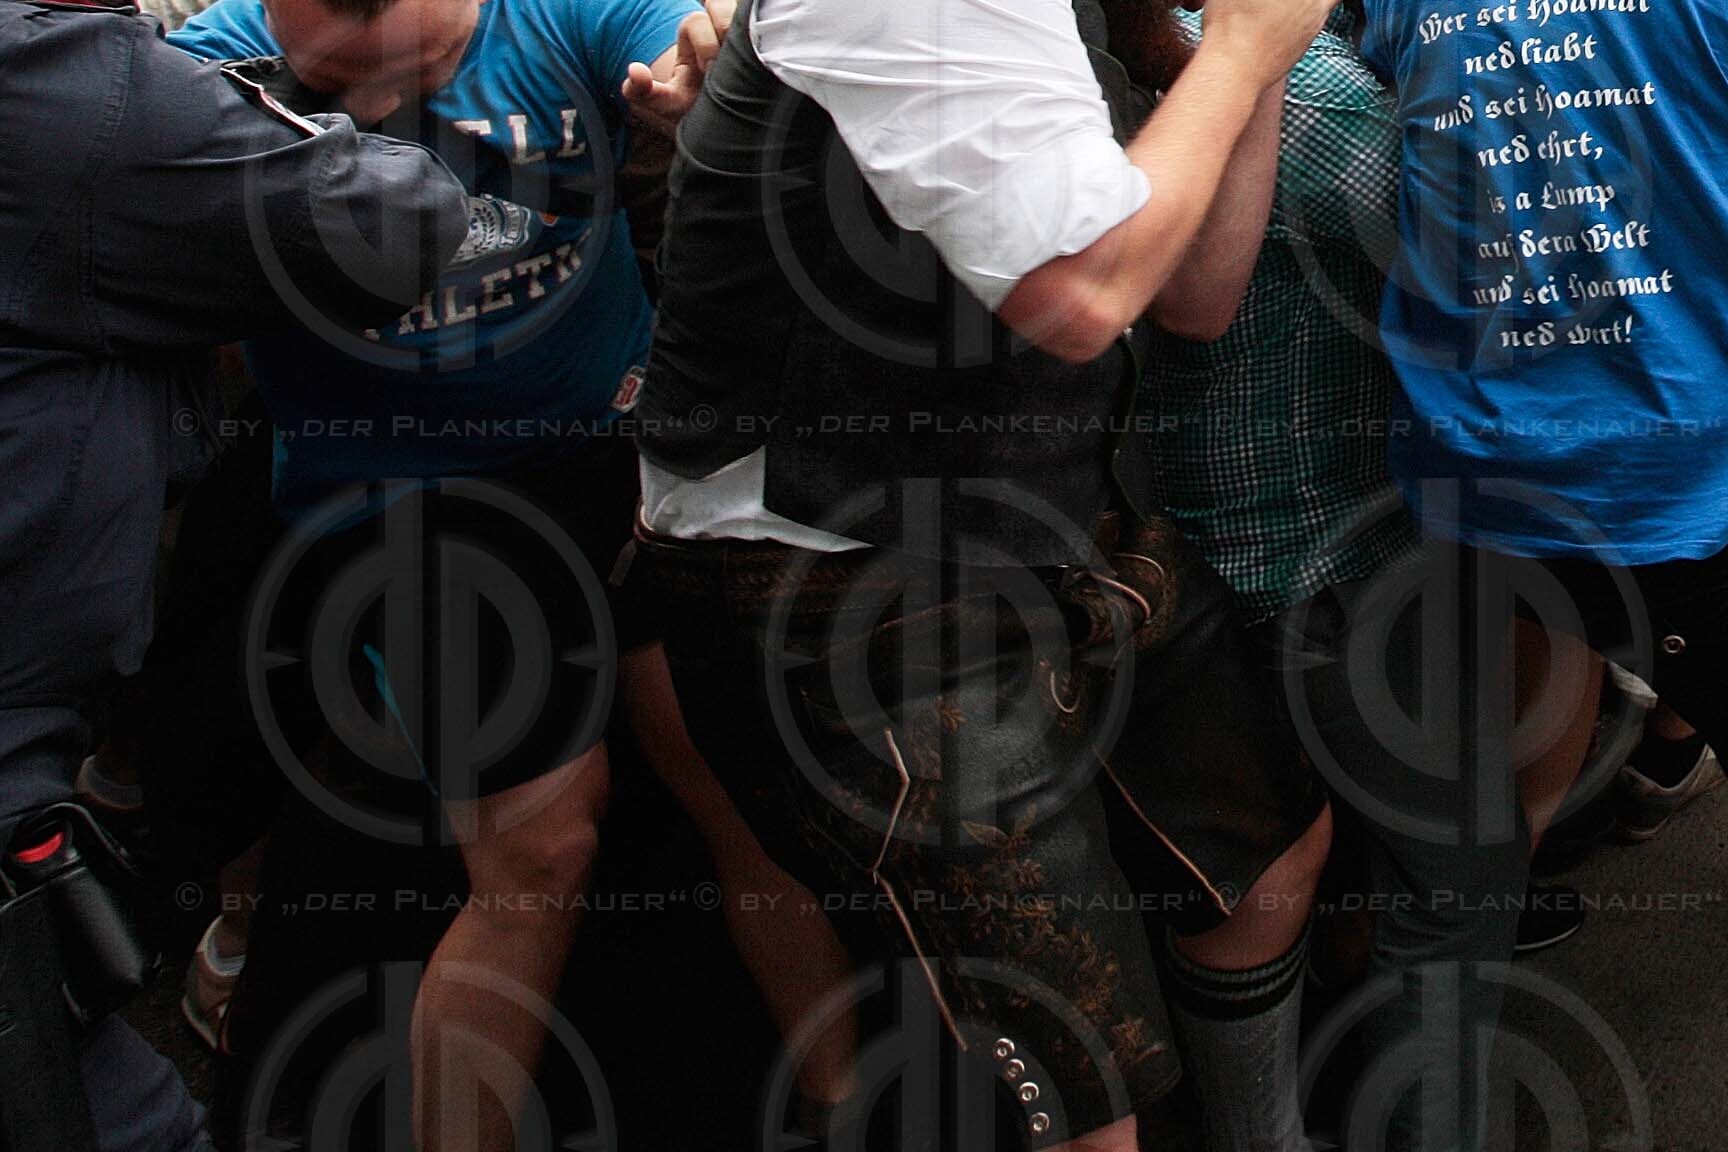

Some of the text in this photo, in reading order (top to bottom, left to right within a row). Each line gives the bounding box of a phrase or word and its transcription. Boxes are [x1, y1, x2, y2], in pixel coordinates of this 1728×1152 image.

[1418, 12, 1468, 45] Wer
[1464, 40, 1516, 75] ned
[1433, 95, 1474, 132] und
[1484, 87, 1527, 120] sei
[1477, 134, 1530, 168] ned
[1515, 192, 1532, 210] a
[1522, 275, 1561, 305] sei
[1500, 321, 1555, 348] ned
